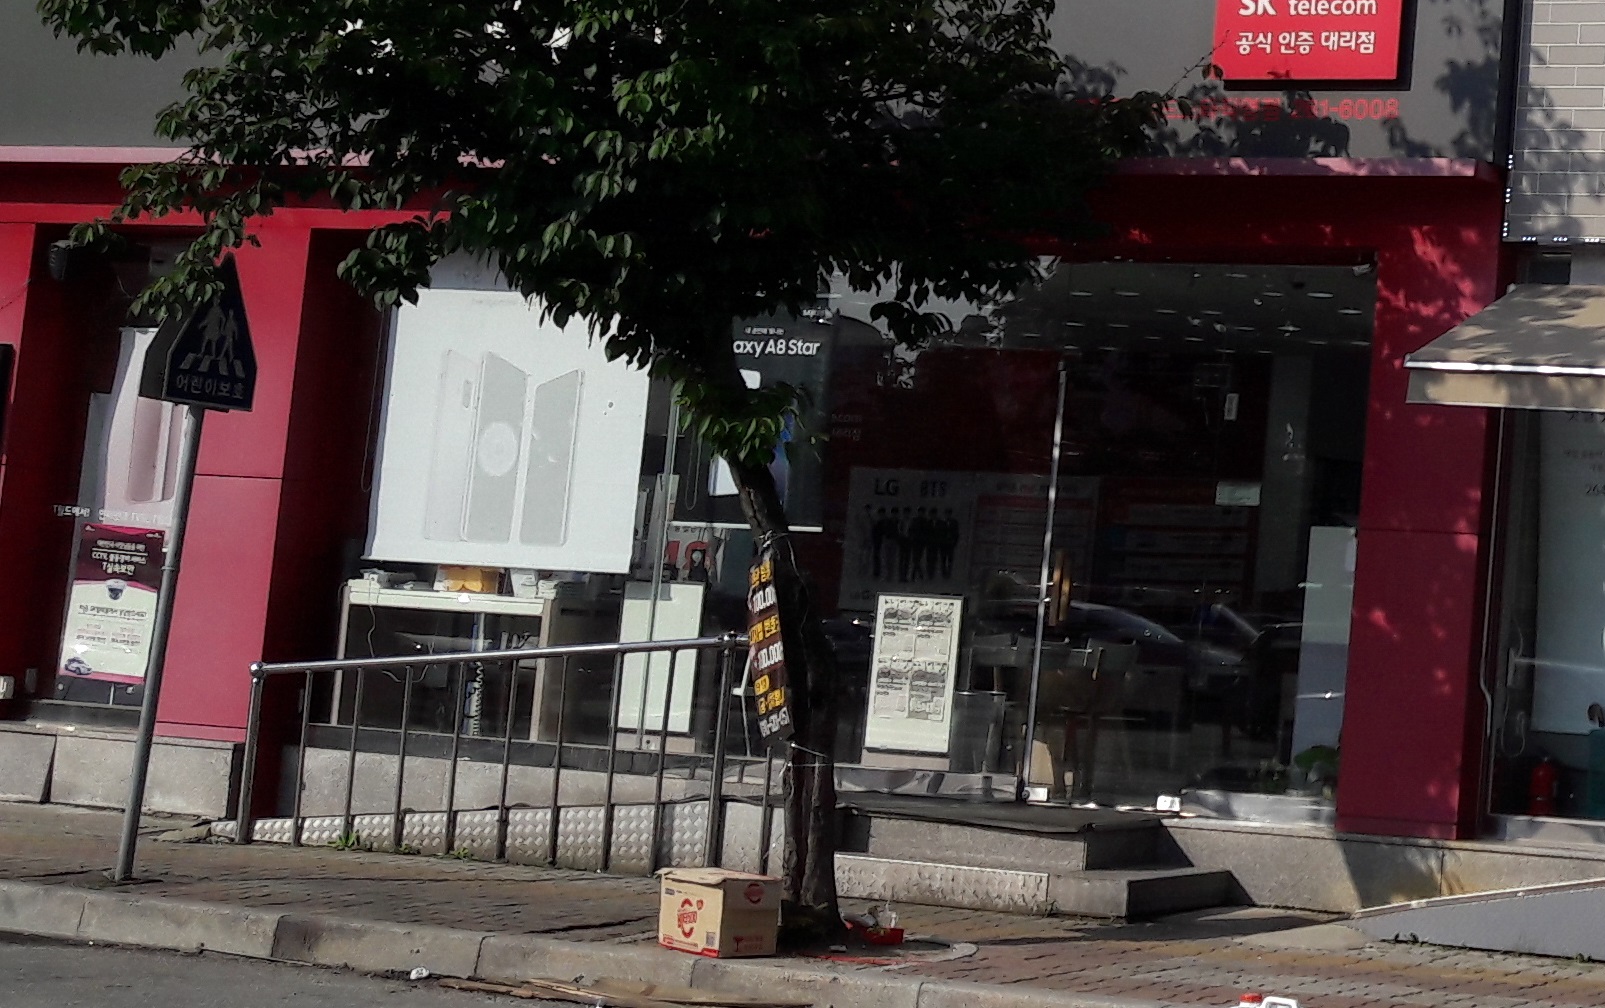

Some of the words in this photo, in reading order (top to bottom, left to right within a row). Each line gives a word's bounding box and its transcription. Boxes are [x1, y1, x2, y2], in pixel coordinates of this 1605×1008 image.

[1236, 32, 1272, 55] 공식
[1278, 32, 1315, 55] 인증
[1320, 31, 1376, 55] 대리점
[733, 340, 765, 359] axy
[766, 339, 786, 355] A8
[788, 339, 821, 356] Star
